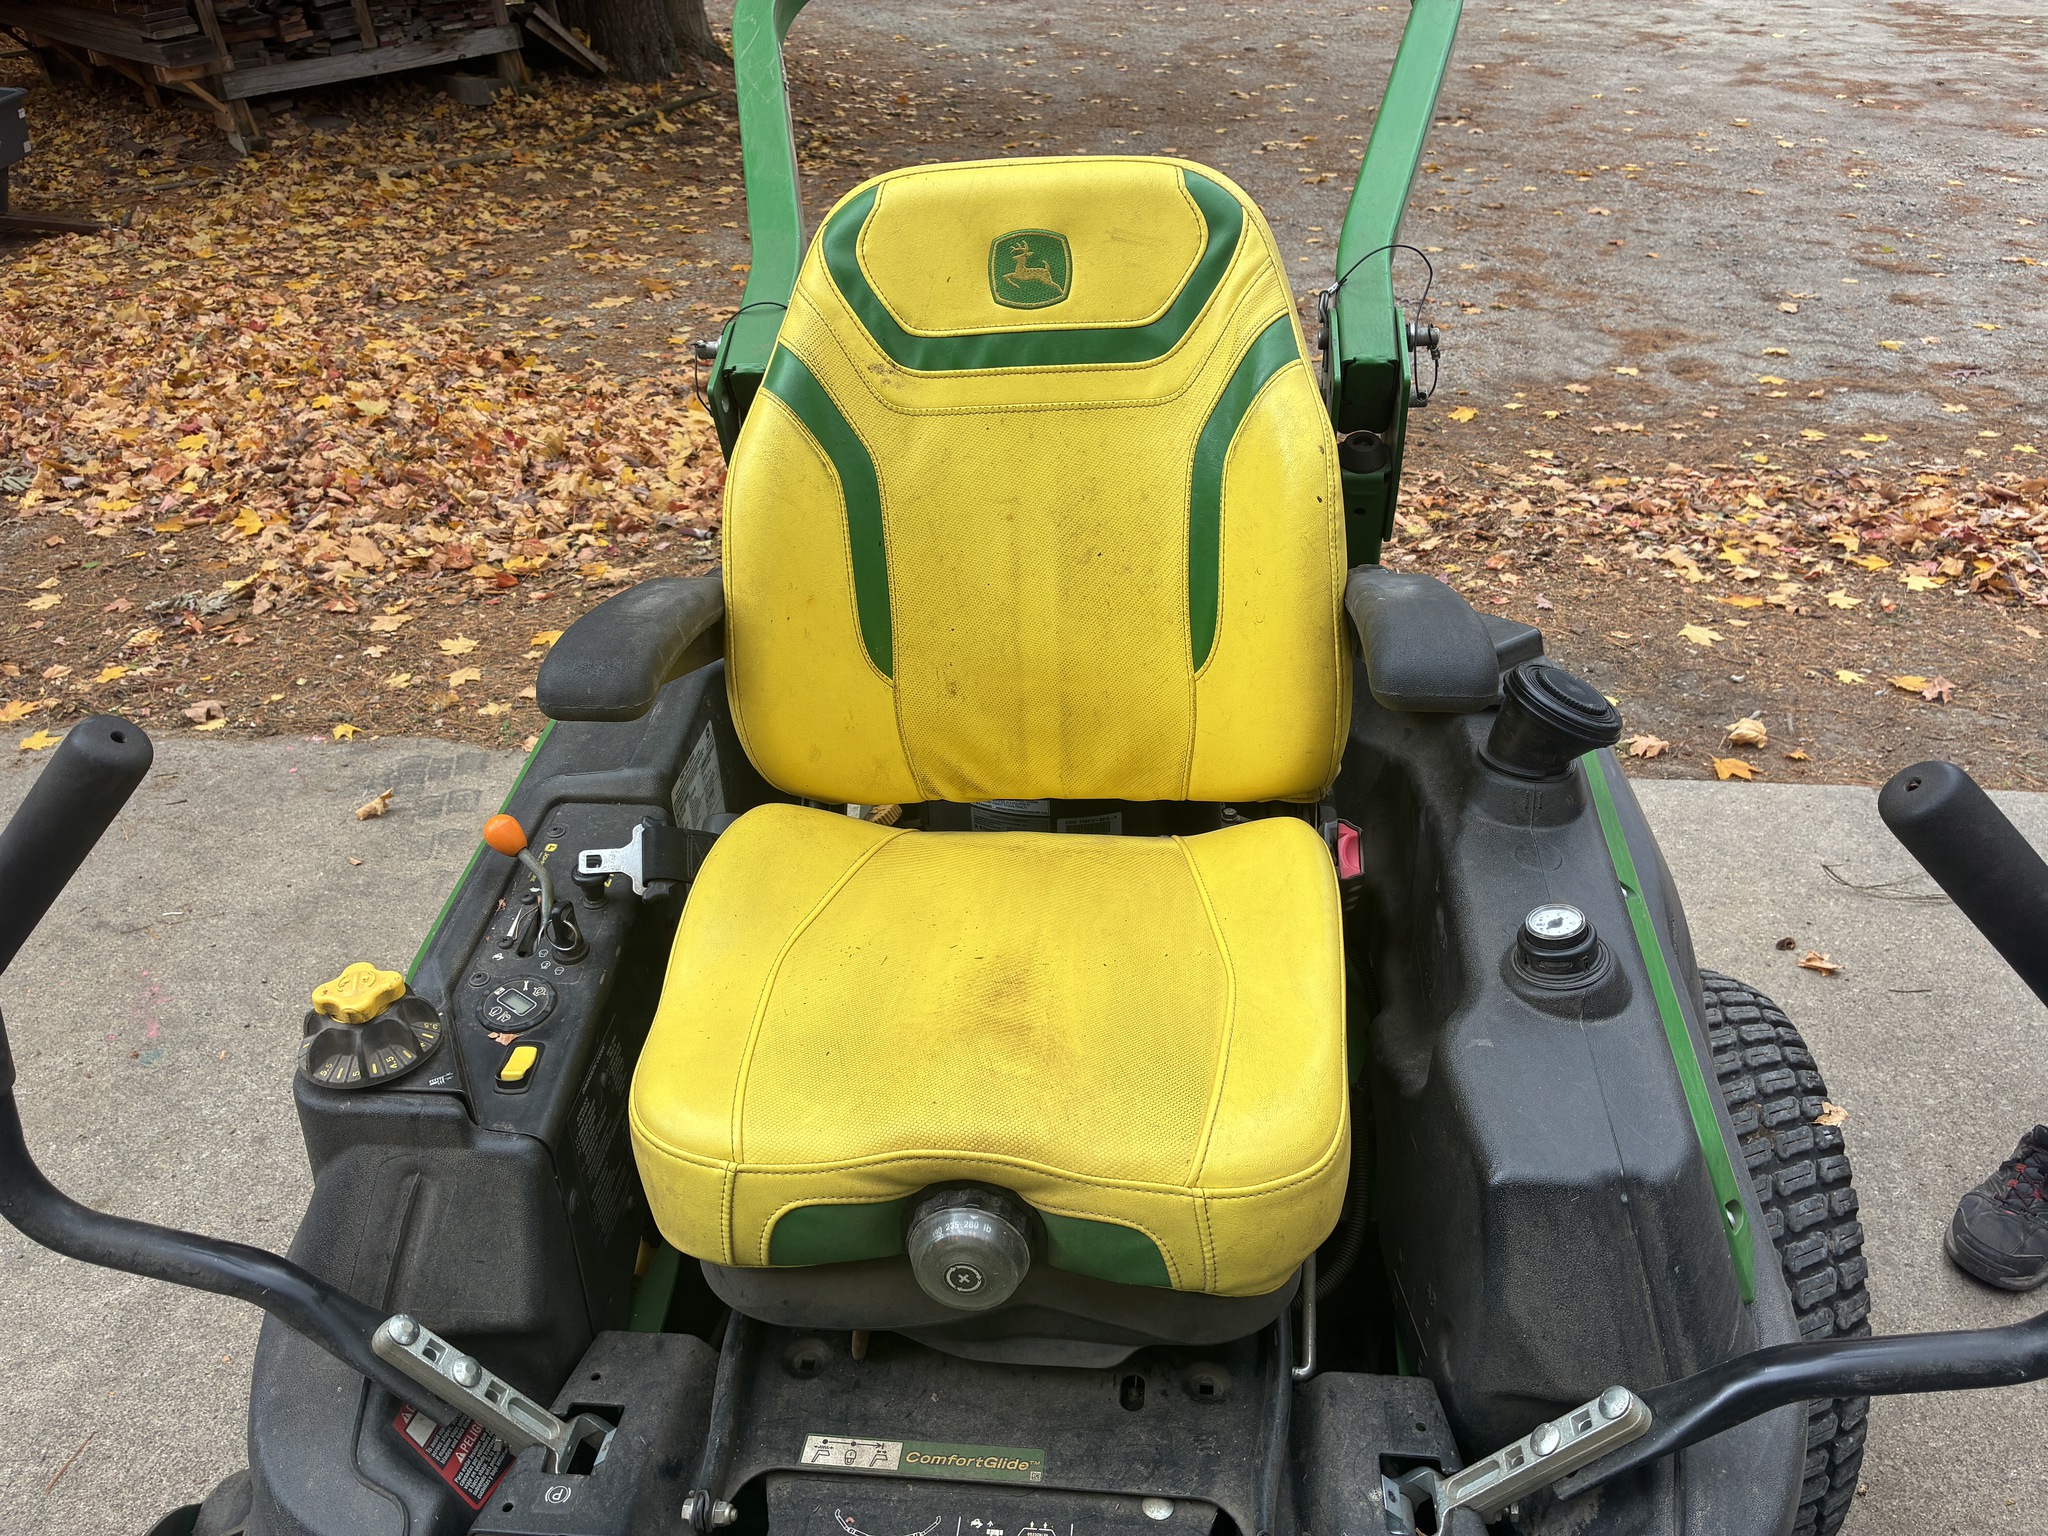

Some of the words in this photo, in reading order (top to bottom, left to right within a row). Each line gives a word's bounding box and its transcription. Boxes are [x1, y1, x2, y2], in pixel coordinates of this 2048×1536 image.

[319, 1062, 333, 1077] 5.5
[385, 1055, 398, 1069] 4.5
[945, 1221, 960, 1231] 235
[963, 1220, 979, 1229] 280
[983, 1223, 992, 1234] lb
[458, 1420, 483, 1452] PELIG
[437, 1436, 452, 1457] machine
[439, 1446, 453, 1464] blades
[449, 1437, 458, 1449] and
[453, 1470, 464, 1483] Para
[458, 1464, 474, 1487] causadas
